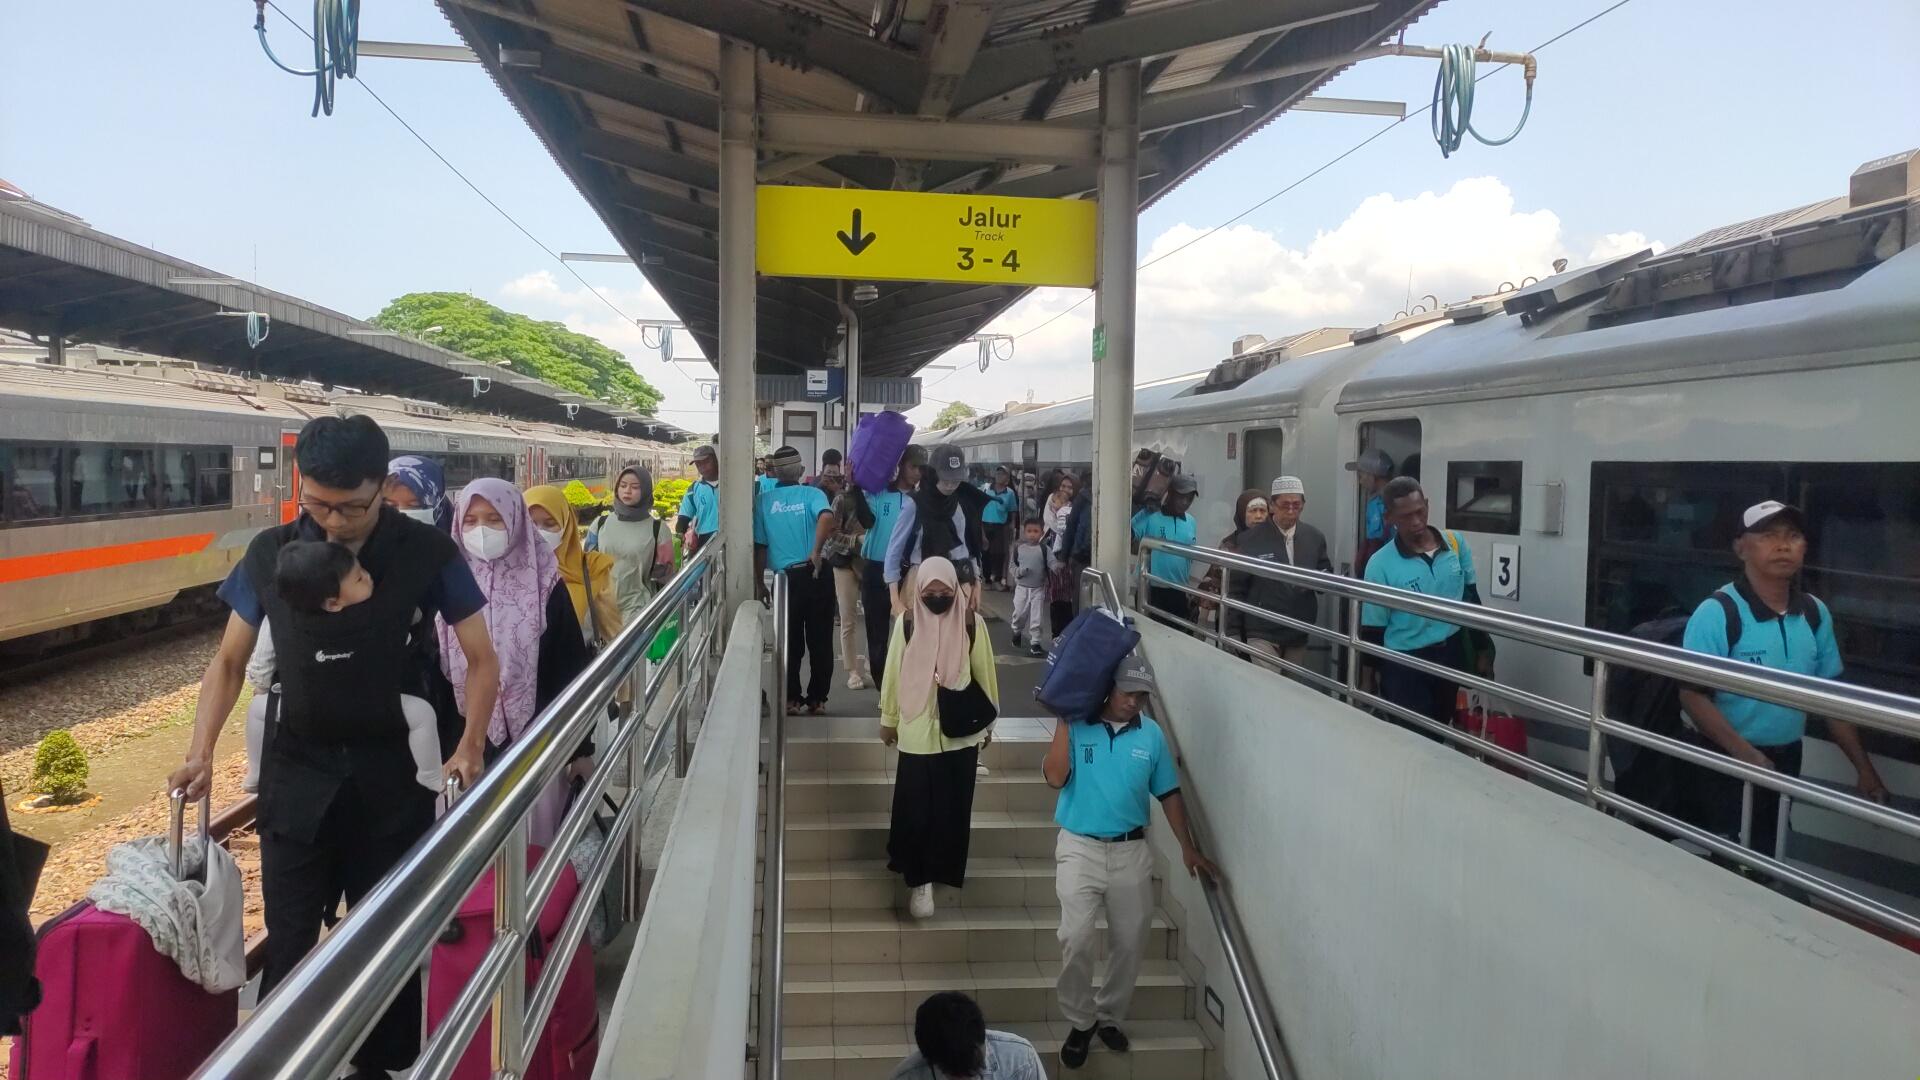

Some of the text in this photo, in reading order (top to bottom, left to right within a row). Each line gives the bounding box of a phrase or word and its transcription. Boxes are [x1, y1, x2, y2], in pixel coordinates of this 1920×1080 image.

[959, 206, 1022, 229] Jalur
[974, 230, 1005, 242] Track
[957, 247, 975, 271] 3
[1001, 249, 1021, 273] 4
[1498, 556, 1511, 586] 3
